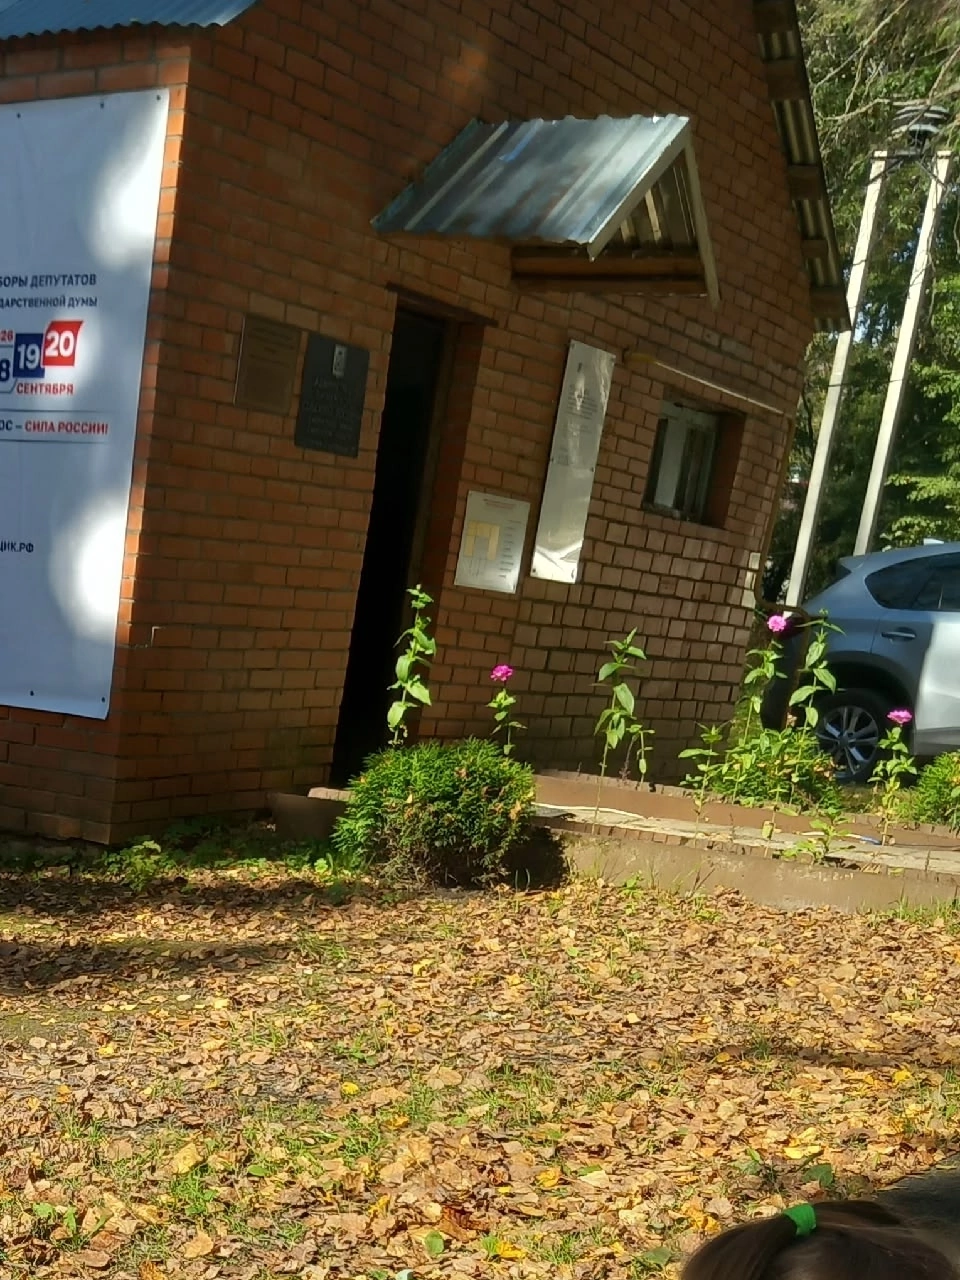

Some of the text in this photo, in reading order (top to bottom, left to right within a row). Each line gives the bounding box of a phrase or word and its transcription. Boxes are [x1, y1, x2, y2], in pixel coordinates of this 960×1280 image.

[30, 273, 97, 289] ДЕПУТАТОВ
[67, 296, 98, 309] ДУМЫ
[17, 343, 40, 370] 19
[44, 330, 75, 357] 20
[16, 382, 74, 395] СЕНТЯБРЯ
[24, 420, 56, 433] СИЛА
[58, 421, 109, 435] РОССИИ!
